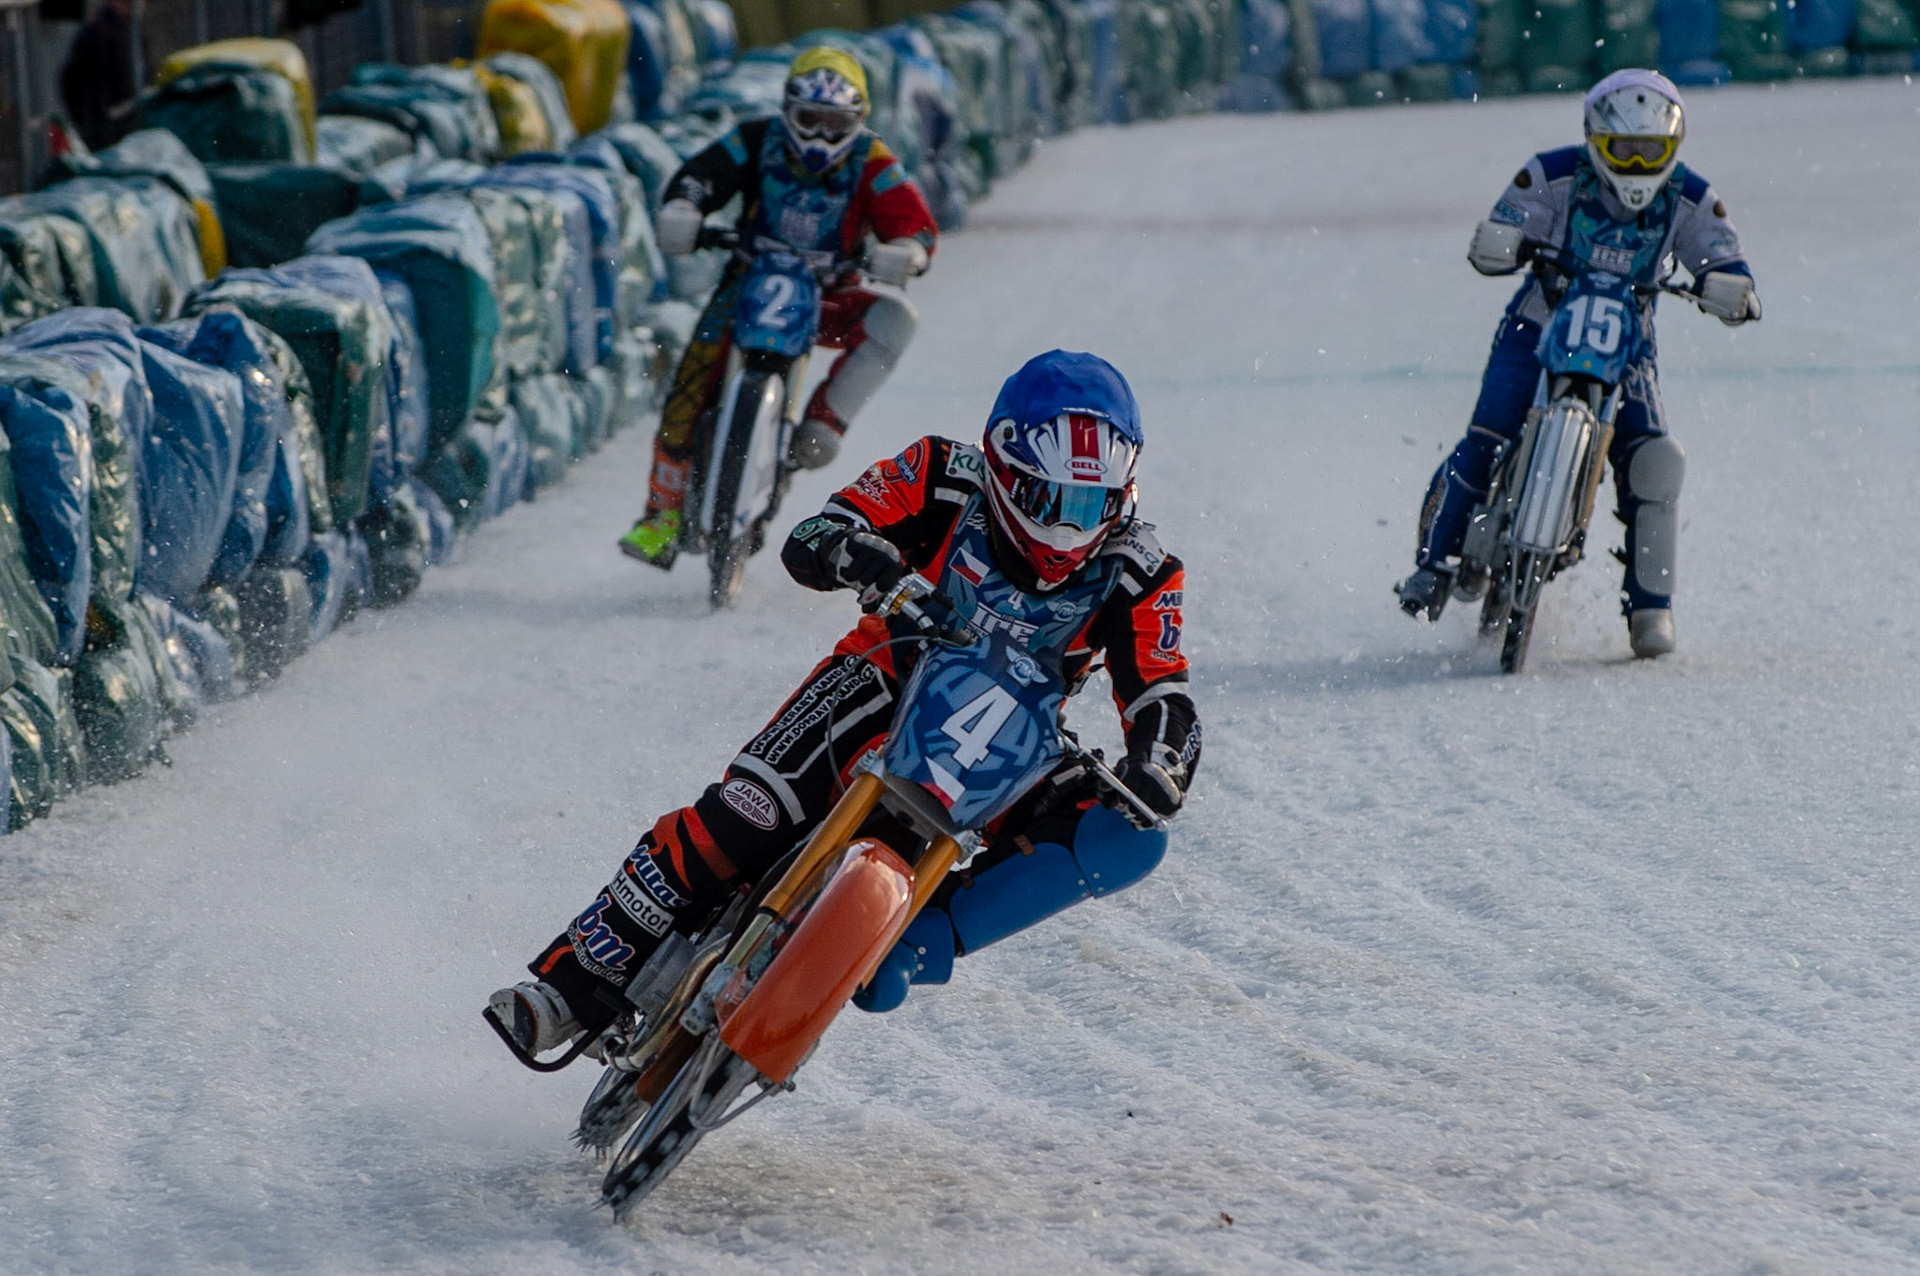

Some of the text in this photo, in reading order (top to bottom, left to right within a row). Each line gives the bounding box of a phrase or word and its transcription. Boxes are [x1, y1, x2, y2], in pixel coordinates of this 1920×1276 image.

[758, 274, 794, 330] 2
[1565, 294, 1624, 355] 15
[1071, 461, 1102, 471] BELL
[1007, 590, 1025, 610] 4
[940, 684, 1020, 770] 4
[734, 784, 771, 814] JAWA
[577, 893, 635, 971] bm
